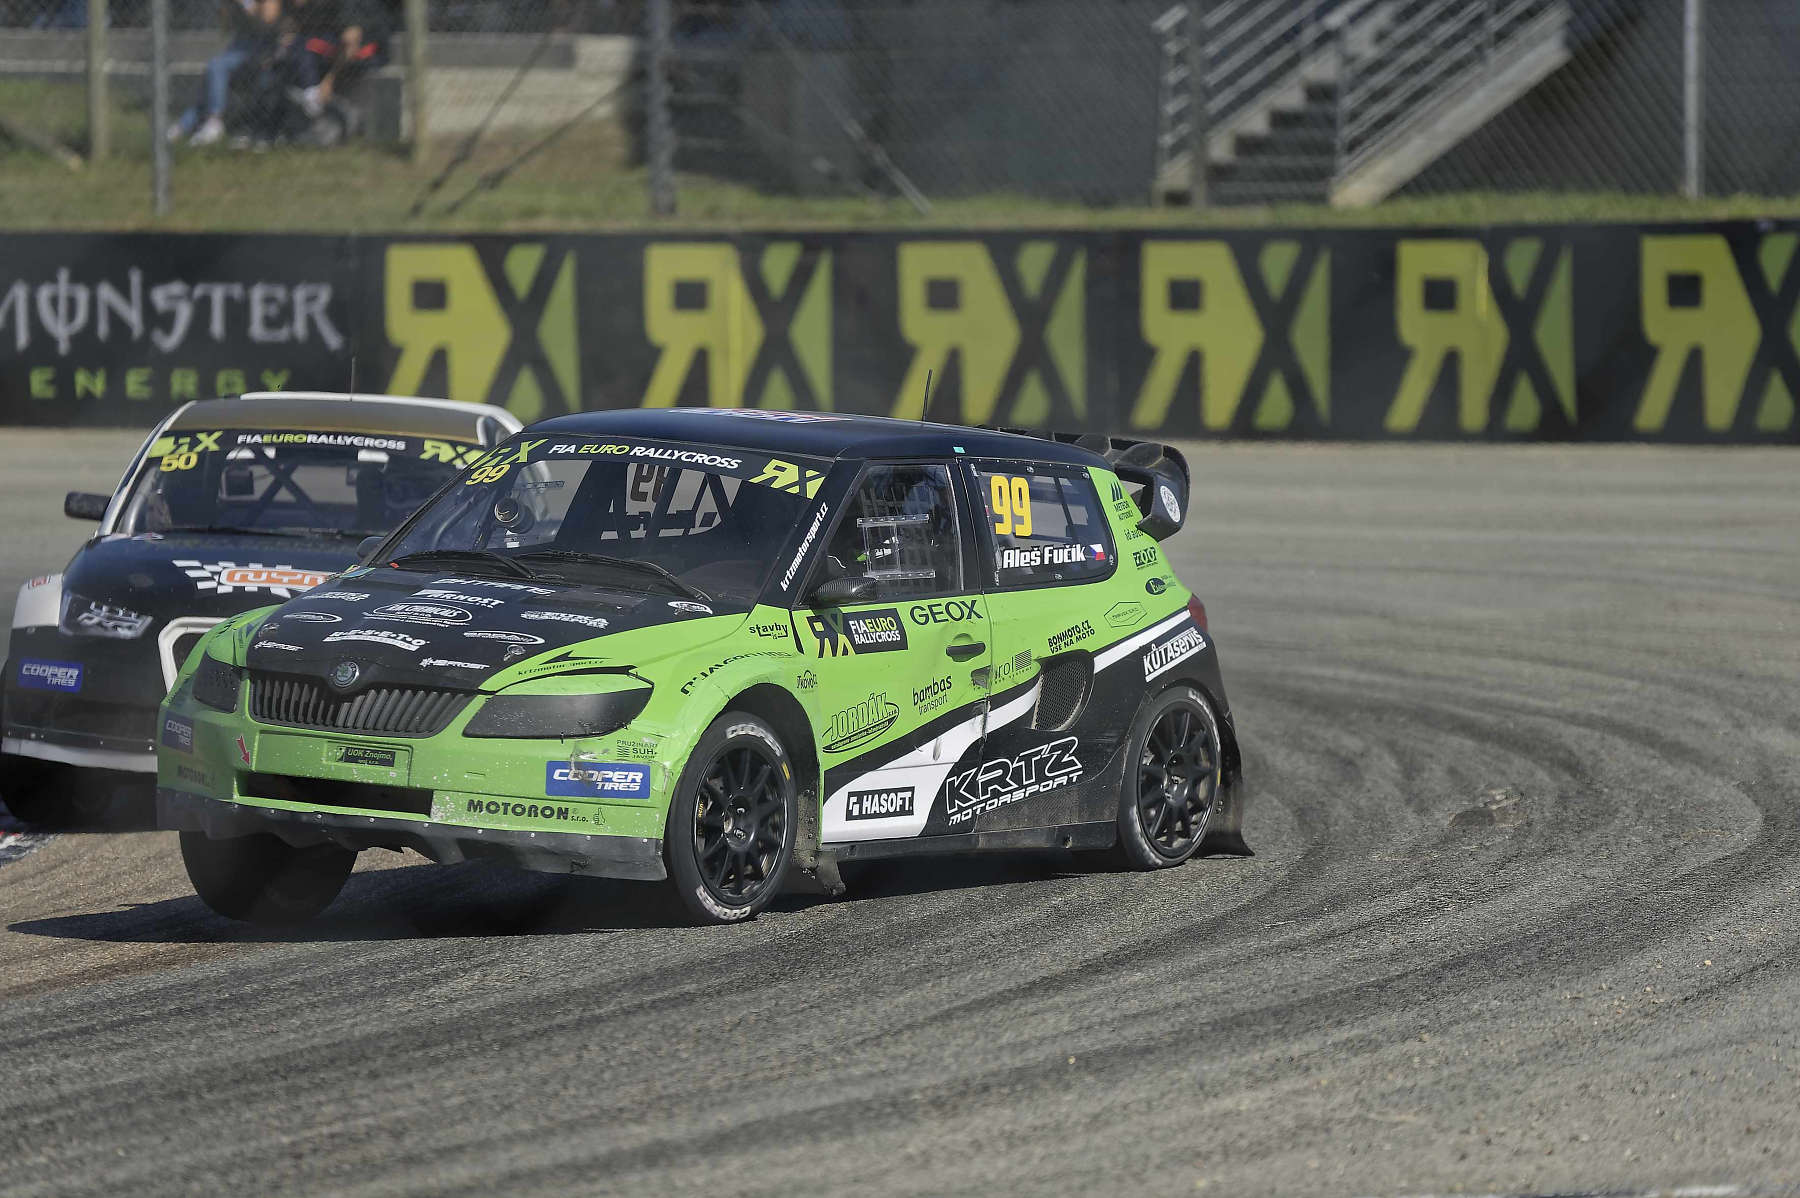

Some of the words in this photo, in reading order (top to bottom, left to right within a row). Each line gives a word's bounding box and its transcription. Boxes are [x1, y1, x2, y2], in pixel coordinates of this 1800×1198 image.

[29, 366, 291, 399] ENERGY
[160, 452, 198, 472] 50
[548, 444, 576, 455] FIA
[578, 444, 629, 456] EURO
[629, 446, 742, 470] RALLYCROSS
[465, 464, 511, 485] 99
[990, 475, 1032, 537] 99
[1003, 545, 1042, 569] Aleš
[1044, 543, 1087, 565] Fučík
[909, 599, 984, 627] GEOX
[854, 630, 901, 645] RALLYCROSS
[1143, 629, 1204, 676] KŮTAservis
[22, 663, 79, 679] COOPER
[48, 677, 76, 687] TIRES
[912, 675, 952, 707] bambas
[918, 693, 949, 715] transport
[830, 692, 889, 741] JORDÁK
[552, 768, 644, 784] COOPER
[596, 781, 641, 791] TIRES
[945, 736, 1083, 815] KRTZ
[466, 799, 570, 820] MOTORON
[948, 770, 1084, 826] MOTORSPORT
